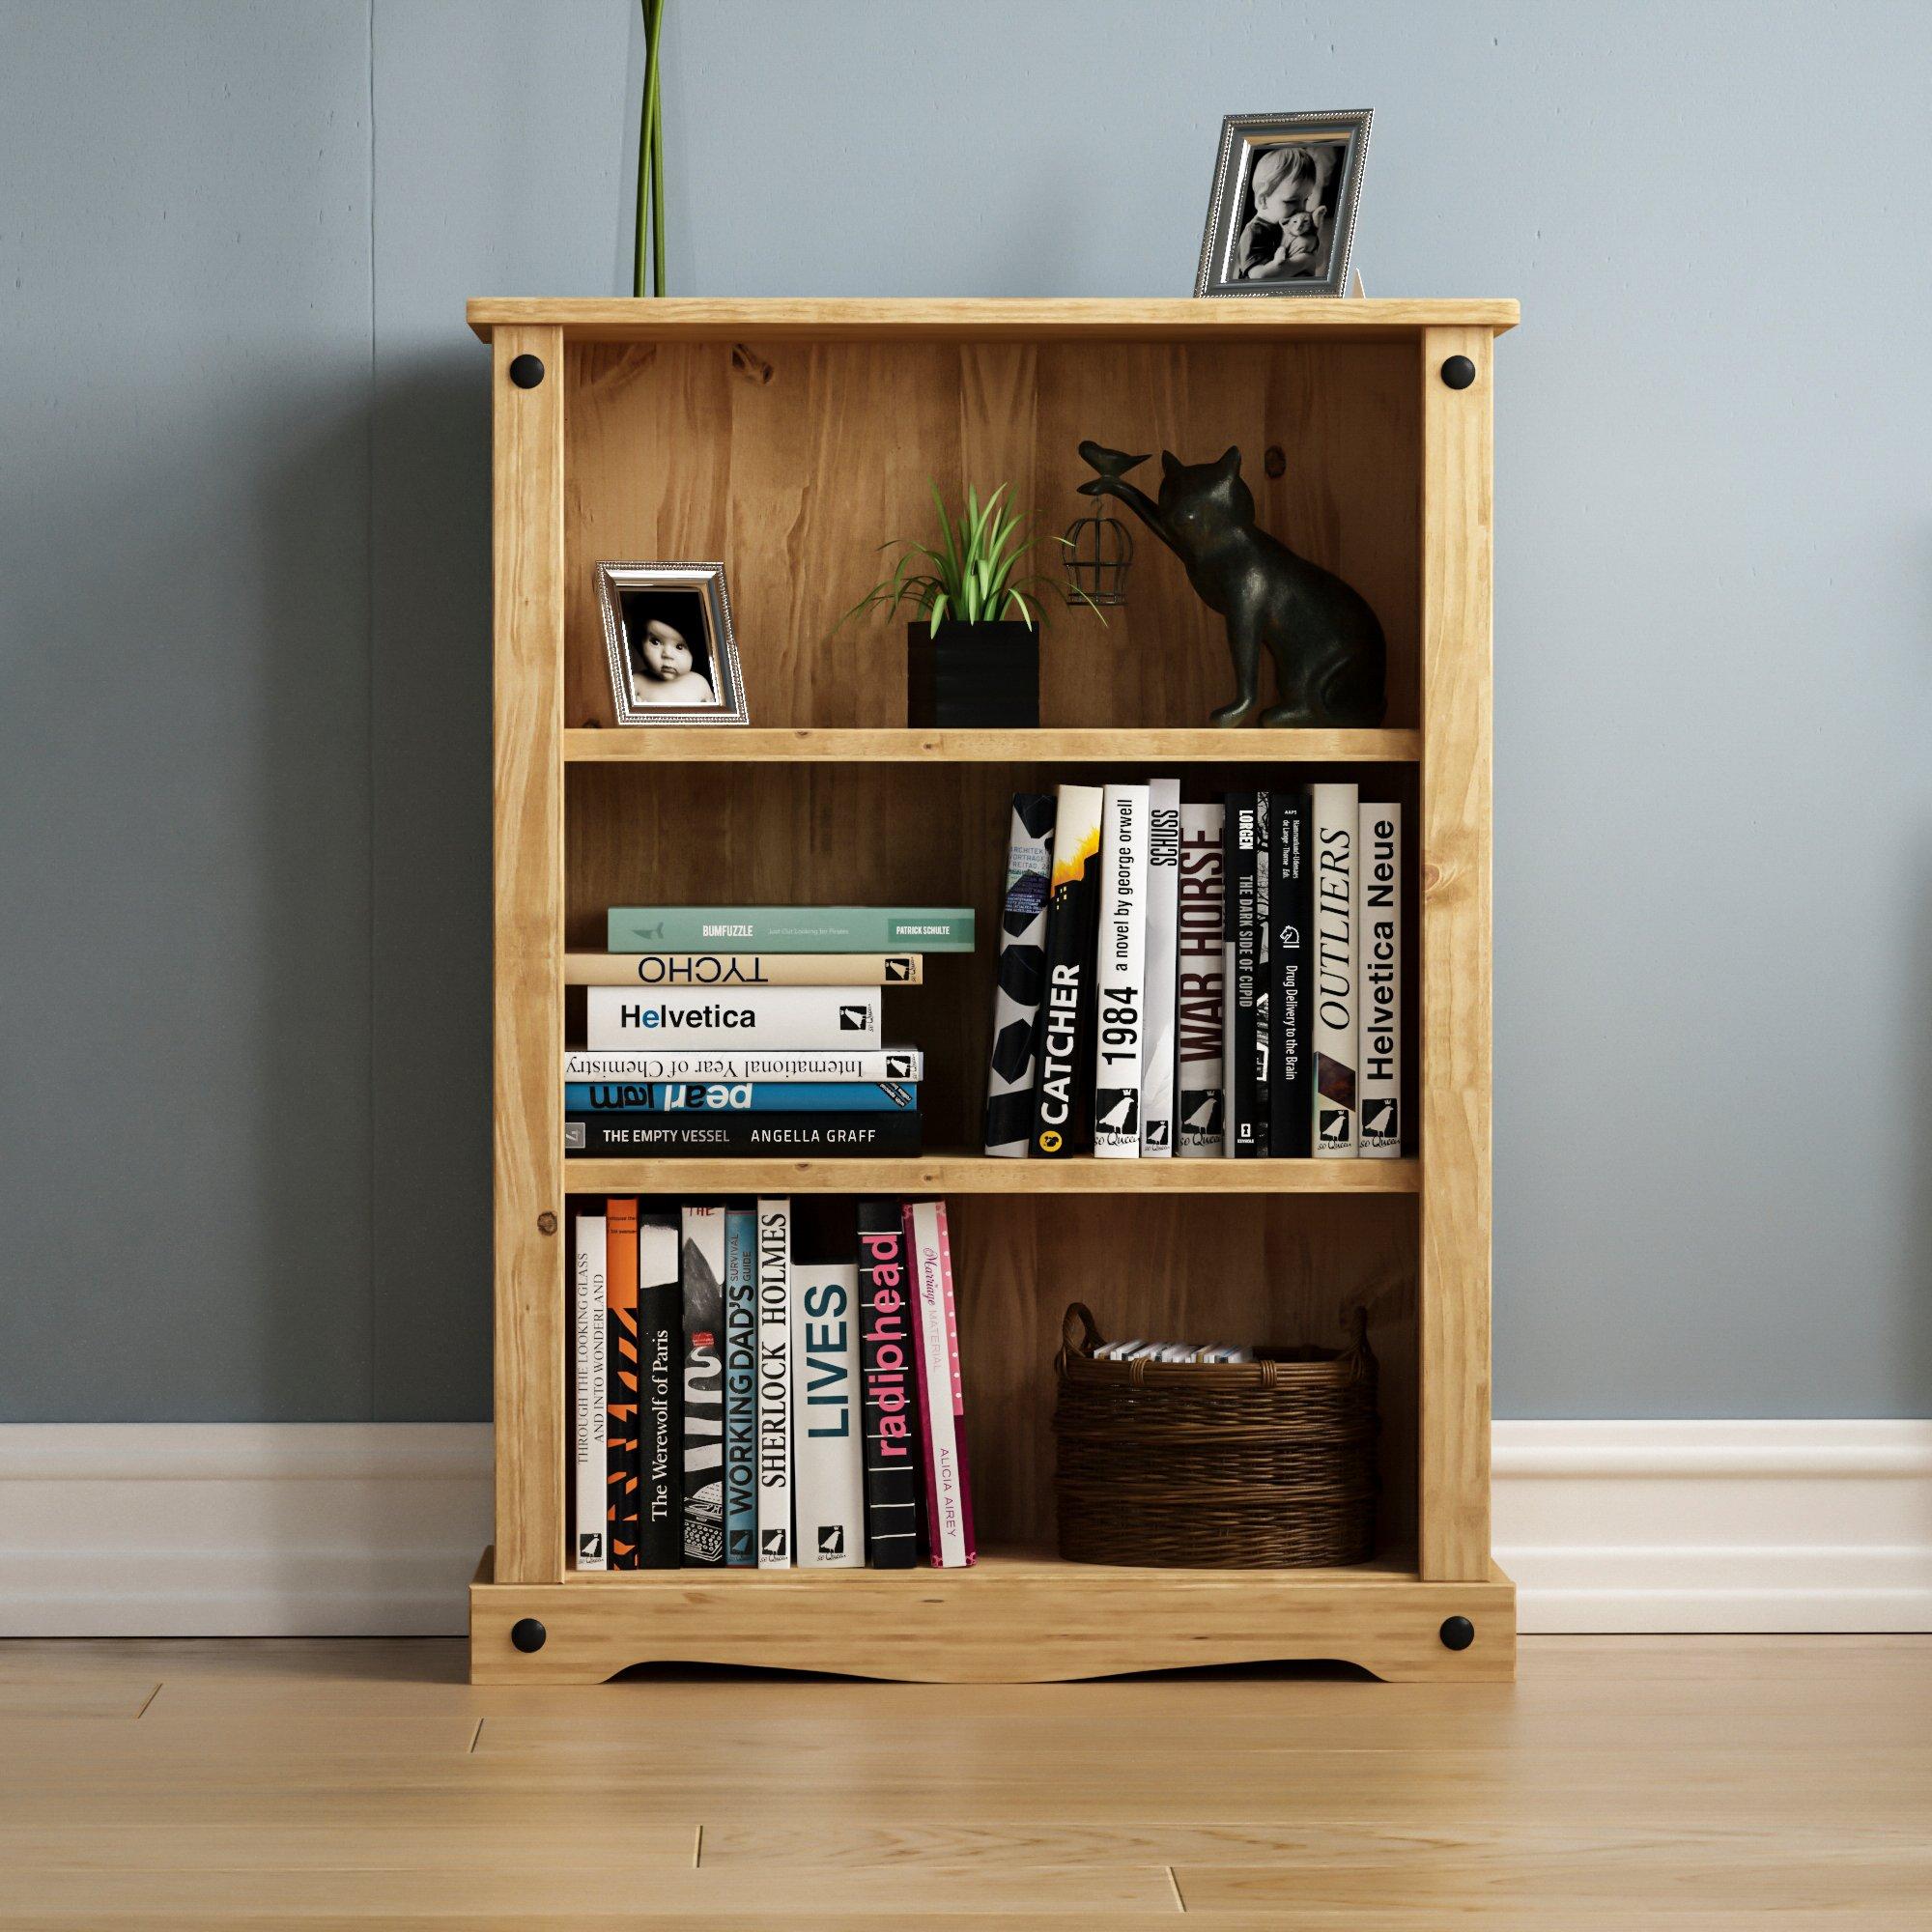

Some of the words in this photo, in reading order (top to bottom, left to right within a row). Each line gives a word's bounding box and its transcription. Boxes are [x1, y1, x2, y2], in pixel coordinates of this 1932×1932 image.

[1117, 799, 1133, 842] orwell
[1151, 810, 1179, 867] SCHUSS
[1238, 810, 1254, 850] LORGEN
[1117, 847, 1134, 895] george
[1367, 820, 1395, 907] Neue
[1179, 827, 1223, 956] HORSE
[1239, 874, 1254, 895] THE
[1114, 899, 1133, 917] by
[1239, 898, 1254, 927] DARK
[702, 924, 753, 937] BUMFUZZLE
[895, 925, 922, 935] PATRICK
[923, 925, 951, 935] SCHULTE
[1114, 921, 1129, 958] novel
[1239, 930, 1254, 954] SIDE
[1320, 827, 1350, 1031] OUTLIERS
[638, 956, 769, 983] TYCHO
[1116, 963, 1128, 972] a
[1239, 958, 1254, 972] OF
[1282, 965, 1298, 987] Drug
[1239, 975, 1254, 1008] CUPID
[1282, 989, 1298, 1026] Delivery
[1367, 922, 1395, 1080] Helvetica
[620, 1004, 756, 1029] Helvetica
[1101, 986, 1139, 1065] 1984
[1179, 973, 1223, 1063] WAR
[1286, 1028, 1296, 1037] to
[1040, 964, 1080, 1125] CATCHER
[1286, 1037, 1298, 1054] the
[565, 1057, 664, 1078] Chemistry
[668, 1060, 689, 1078] of
[695, 1060, 738, 1078] Year
[745, 1060, 863, 1078] International
[1286, 1056, 1298, 1080] Brain
[664, 1082, 753, 1112] pearl
[603, 1129, 630, 1143] THE
[633, 1129, 678, 1143] EMPTY
[681, 1129, 730, 1143] VESSEL
[751, 1129, 820, 1143] ANGELLA
[826, 1129, 876, 1143] GRAFF
[578, 1253, 588, 1296] GLASS
[730, 1234, 739, 1282] SURVIVAL
[743, 1251, 752, 1282] GUIDE
[761, 1213, 786, 1326] HOLMES
[923, 1247, 938, 1306] Marriage
[578, 1300, 588, 1363] LOOKING
[593, 1274, 605, 1373] WONDERLAND
[729, 1285, 754, 1371] DAD'S
[652, 1329, 668, 1373] Paris
[804, 1283, 850, 1438] LIVES
[862, 1234, 908, 1457] radiohead
[578, 1366, 588, 1393] THE
[593, 1377, 605, 1409] INTO
[652, 1376, 668, 1395] of
[578, 1398, 588, 1464] THROUGH
[593, 1413, 605, 1443] AND
[761, 1341, 786, 1488] SHERLOCK
[651, 1397, 668, 1481] Werewolf
[729, 1375, 753, 1516] WORKING
[940, 1448, 952, 1492] ALICIA
[651, 1484, 668, 1522] The
[944, 1496, 956, 1537] AIREY
